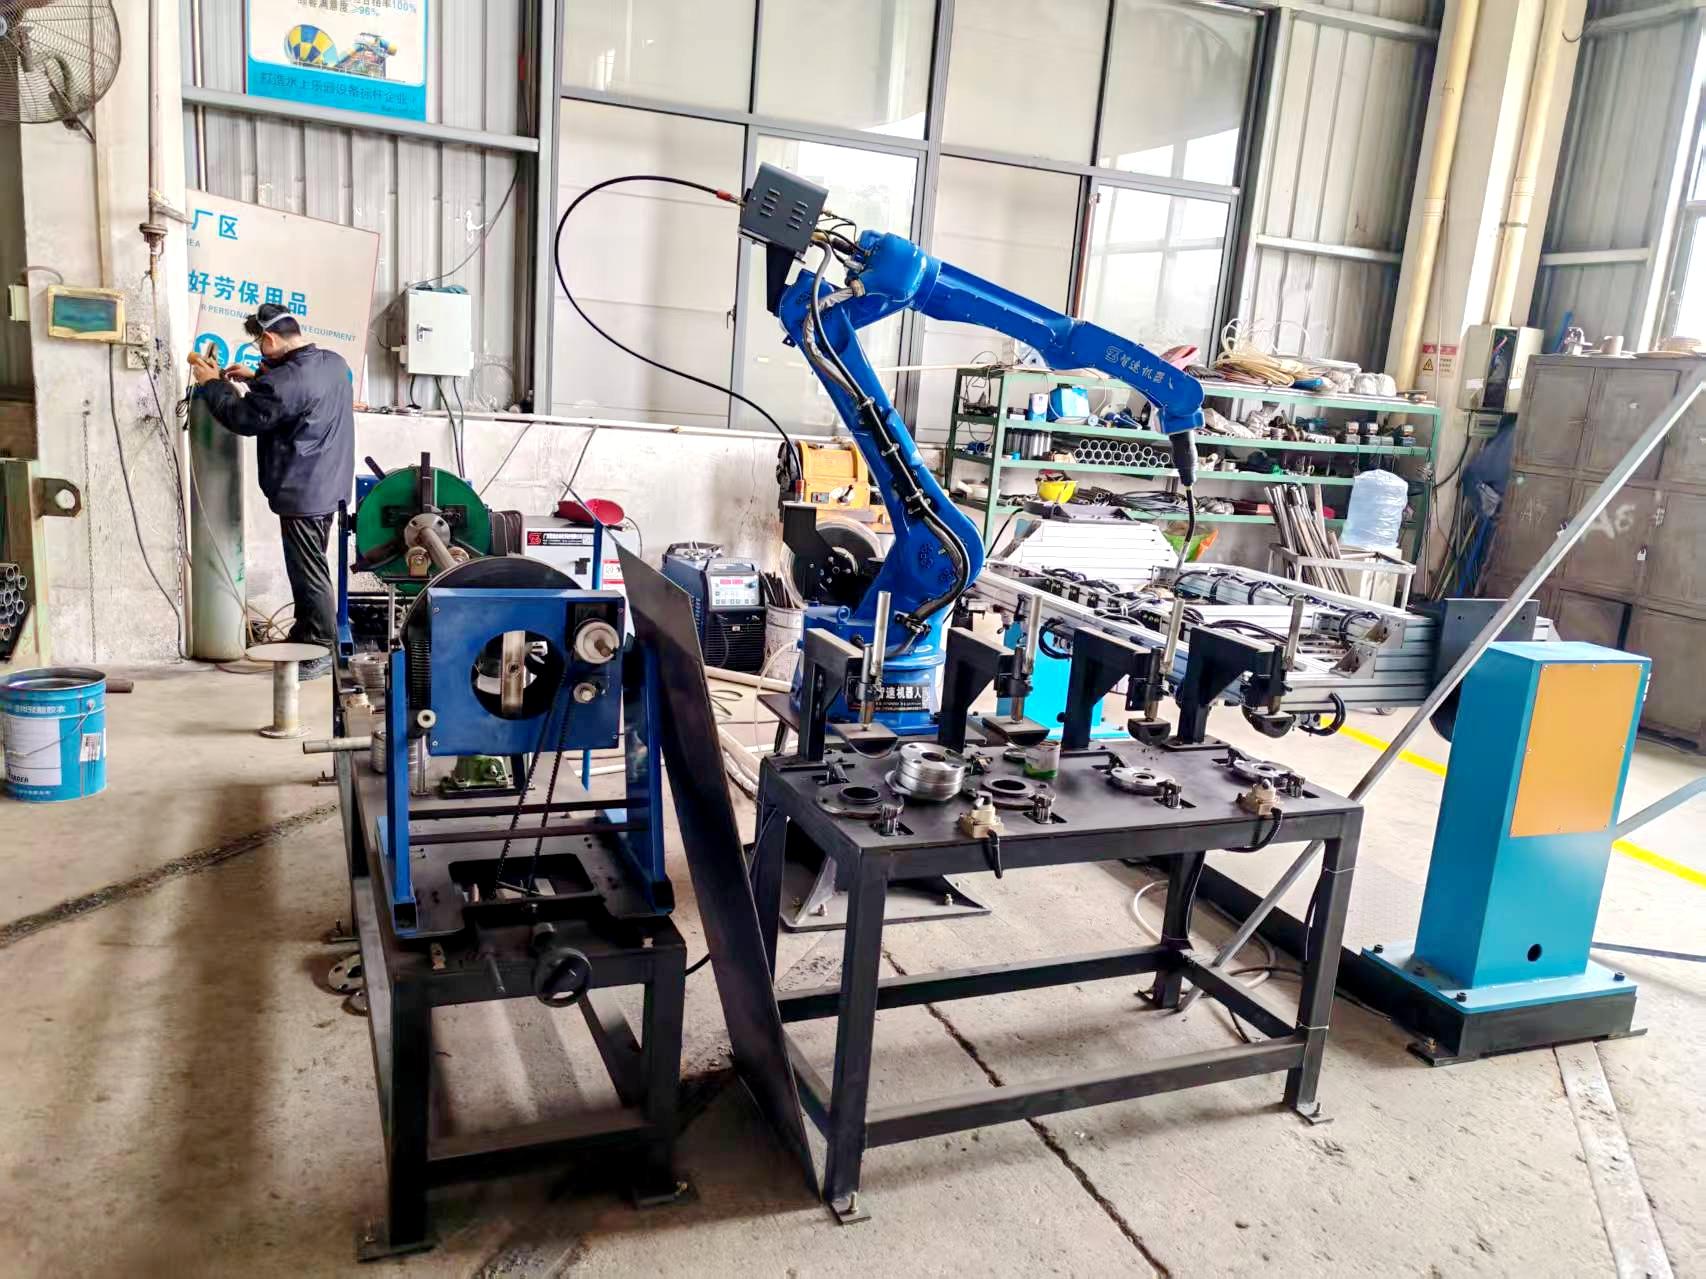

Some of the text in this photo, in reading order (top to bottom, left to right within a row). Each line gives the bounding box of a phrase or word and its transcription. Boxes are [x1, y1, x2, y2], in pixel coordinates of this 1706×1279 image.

[191, 208, 239, 240] 厂区
[188, 269, 308, 317] 好劳保用品
[207, 305, 252, 319] PERSONA
[308, 326, 356, 342] EQUIPMENT
